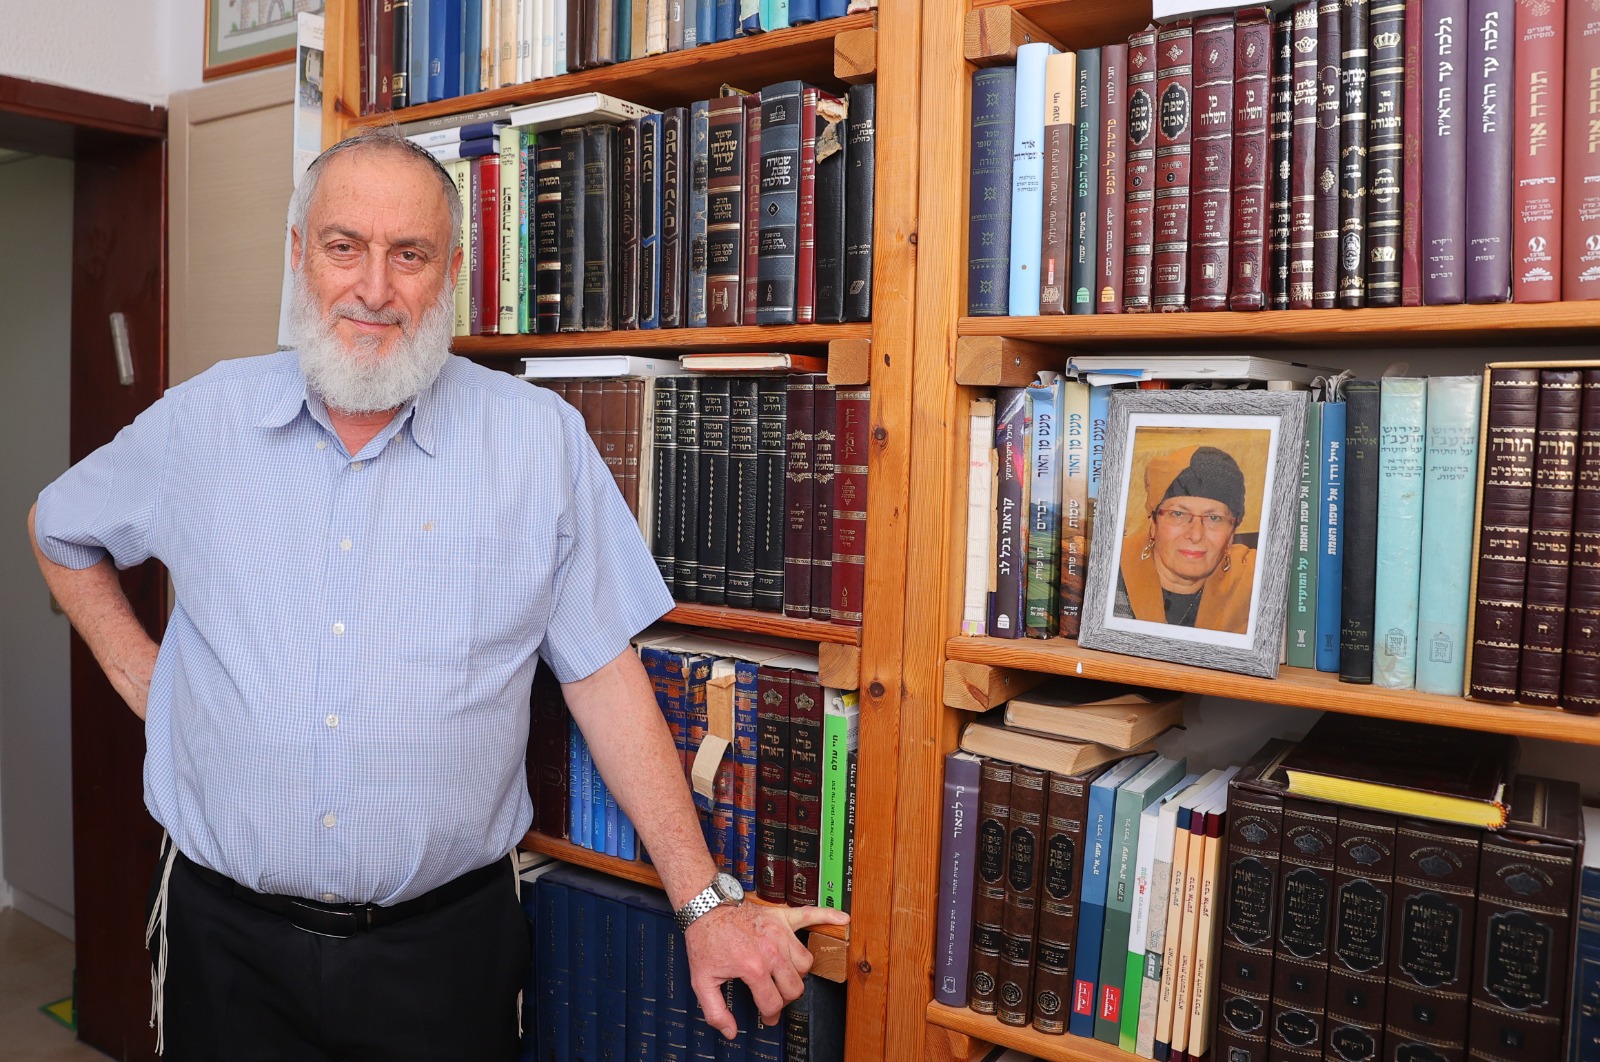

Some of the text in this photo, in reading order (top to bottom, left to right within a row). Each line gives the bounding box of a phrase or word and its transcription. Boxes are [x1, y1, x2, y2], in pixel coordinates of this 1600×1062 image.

[1523, 30, 1555, 41] לחסידות
[1526, 25, 1552, 35] שערים
[1434, 16, 1454, 136] נלכה עד הראי"ה
[1480, 11, 1499, 134] נלכה עד הראי"ה
[1080, 84, 1088, 108] לונדין
[1107, 82, 1116, 105] לונדין
[1322, 83, 1334, 95] קול
[621, 103, 634, 114] פסח
[1130, 106, 1148, 118] שפת
[1163, 100, 1184, 113] שפת
[1238, 102, 1263, 121] השלוח
[1318, 100, 1339, 111] שמחה
[1378, 101, 1393, 113] זהב
[1200, 107, 1227, 126] השלוח
[1529, 70, 1548, 157] תורה אור
[1130, 120, 1147, 132] אמת
[1163, 115, 1184, 127] אמת
[1371, 117, 1401, 129] המנורה
[984, 130, 1000, 138] ספר
[1080, 122, 1089, 150] פרשה
[1107, 119, 1116, 148] פרשה
[710, 138, 738, 154] שולחן
[643, 132, 652, 182] חנוכה
[714, 152, 734, 166] ערוך
[766, 155, 792, 168] שמירת
[1052, 148, 1060, 162] עדין
[1076, 153, 1088, 168] של
[1103, 151, 1116, 166] של
[771, 165, 792, 176] שבת
[1051, 165, 1059, 179] אבן
[663, 130, 676, 228] טבילת כלים
[762, 175, 790, 188] כהלכתה
[1080, 171, 1088, 197] הנפש
[1106, 169, 1115, 195] הנפש
[1520, 177, 1556, 187] בראשית
[622, 138, 634, 235] בין לשבועות
[1049, 182, 1058, 205] ישראל
[749, 162, 759, 256] הלכות חגים
[1204, 200, 1218, 208] חלק
[1240, 196, 1255, 208] חלק
[1106, 208, 1115, 225] ויקרא
[502, 187, 511, 282] המסורת היהודית
[1048, 210, 1058, 245] שטיינזלץ
[1432, 238, 1452, 246] ויקרא
[1471, 237, 1500, 246] בראשית
[1474, 254, 1495, 262] שמות
[1070, 414, 1082, 436] מעט
[1094, 419, 1106, 442] מעט
[1382, 426, 1420, 434] פירוש
[1432, 426, 1471, 434] פירוש
[841, 408, 858, 459] דרך המלך
[1346, 435, 1376, 446] אליהו
[1070, 440, 1083, 451] מן
[1461, 447, 1472, 456] על
[1492, 437, 1533, 452] תורה
[1539, 440, 1575, 456] תורה
[1069, 454, 1080, 477] האור
[1035, 414, 1052, 580] מעט מן האור דברים חנן פורת
[1328, 441, 1339, 555] אייל ורד אל שפת האמת
[1069, 499, 1078, 528] שמות
[998, 497, 1015, 576] קראתי בכל לב
[1069, 542, 1078, 554] חנן
[1298, 486, 1309, 612] אל שפת האמת על המועדים
[1490, 539, 1519, 549] דברים
[1533, 541, 1566, 552] במדבר
[1349, 619, 1361, 627] על
[764, 733, 780, 745] פרי
[796, 738, 812, 749] פרי
[761, 744, 784, 758] הארץ
[792, 749, 817, 763] הארץ
[952, 785, 965, 860] נר למאור על
[1201, 897, 1209, 917] אלישע
[1342, 1038, 1365, 1051] ויקרא
